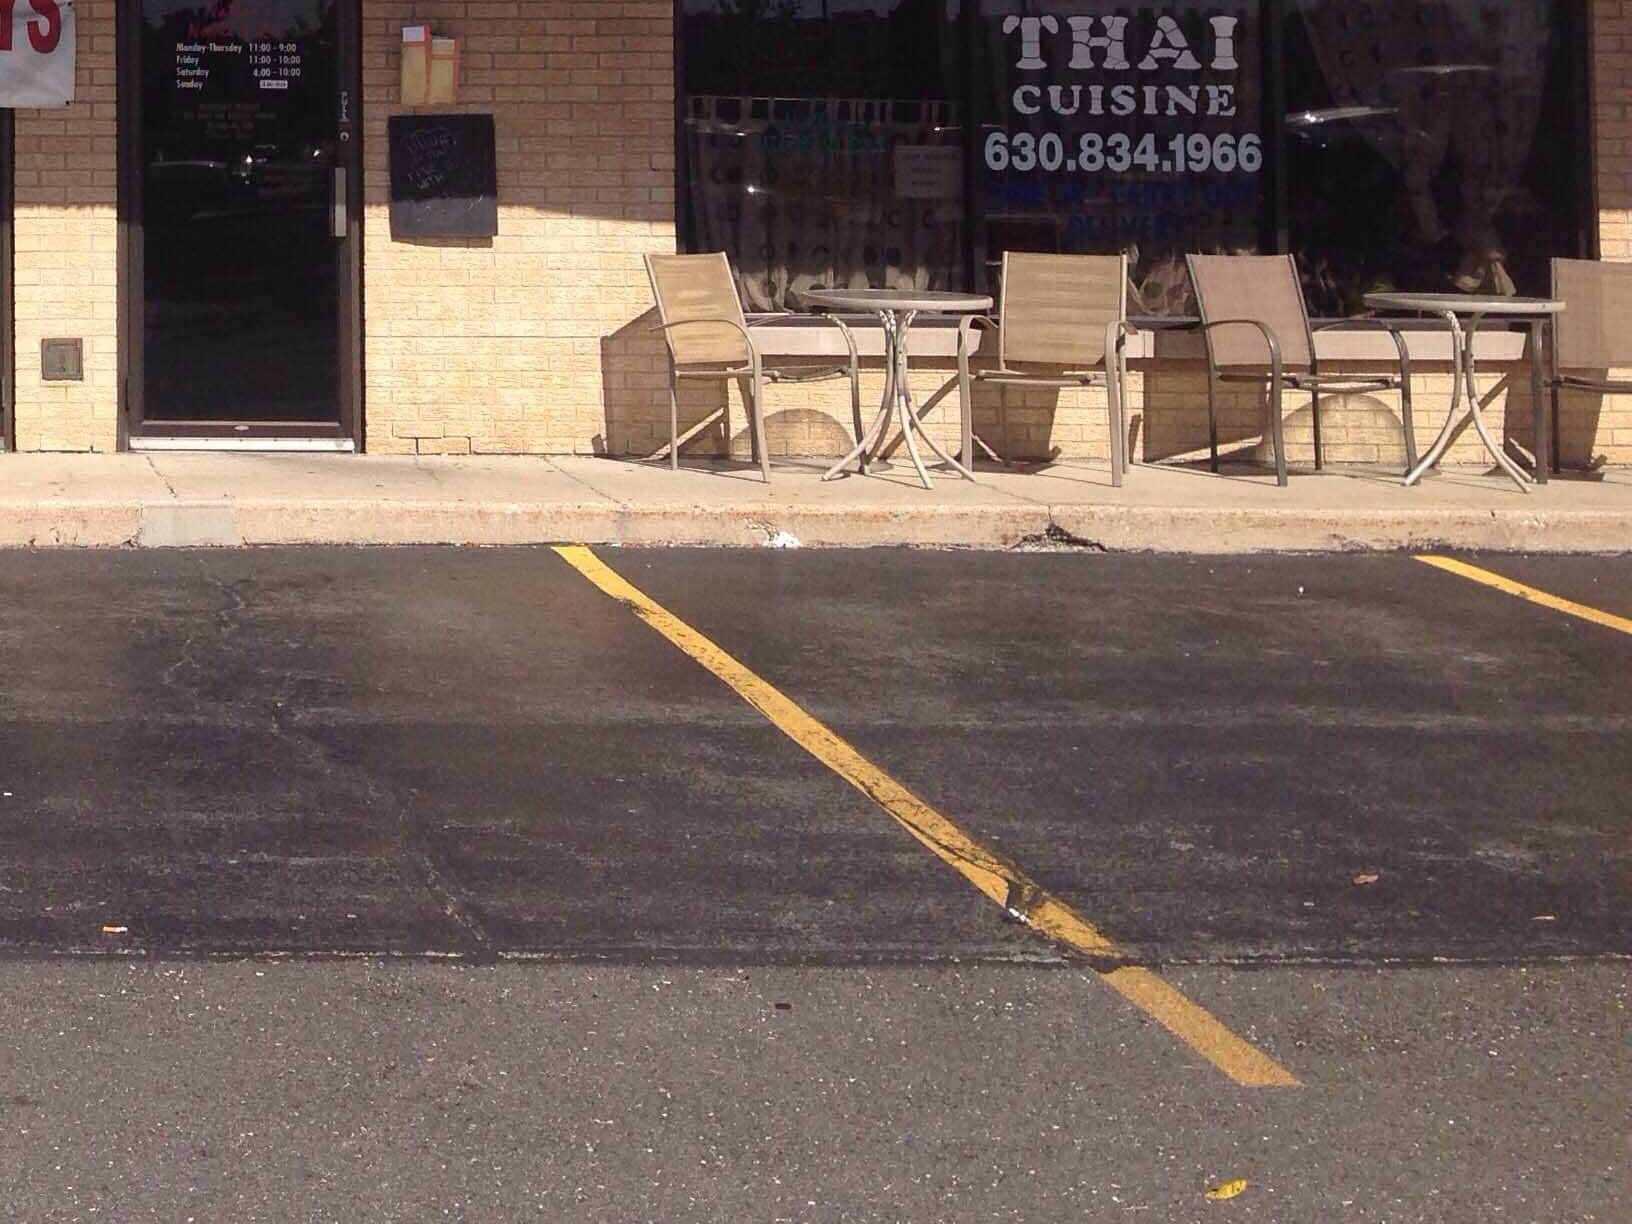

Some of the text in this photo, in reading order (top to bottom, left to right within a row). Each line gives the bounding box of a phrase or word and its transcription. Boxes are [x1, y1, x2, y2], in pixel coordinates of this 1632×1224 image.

[1002, 15, 1239, 70] THAI
[176, 55, 199, 66] Friday
[1012, 85, 1237, 116] CUISINE
[984, 132, 1263, 172] 630.834.1966
